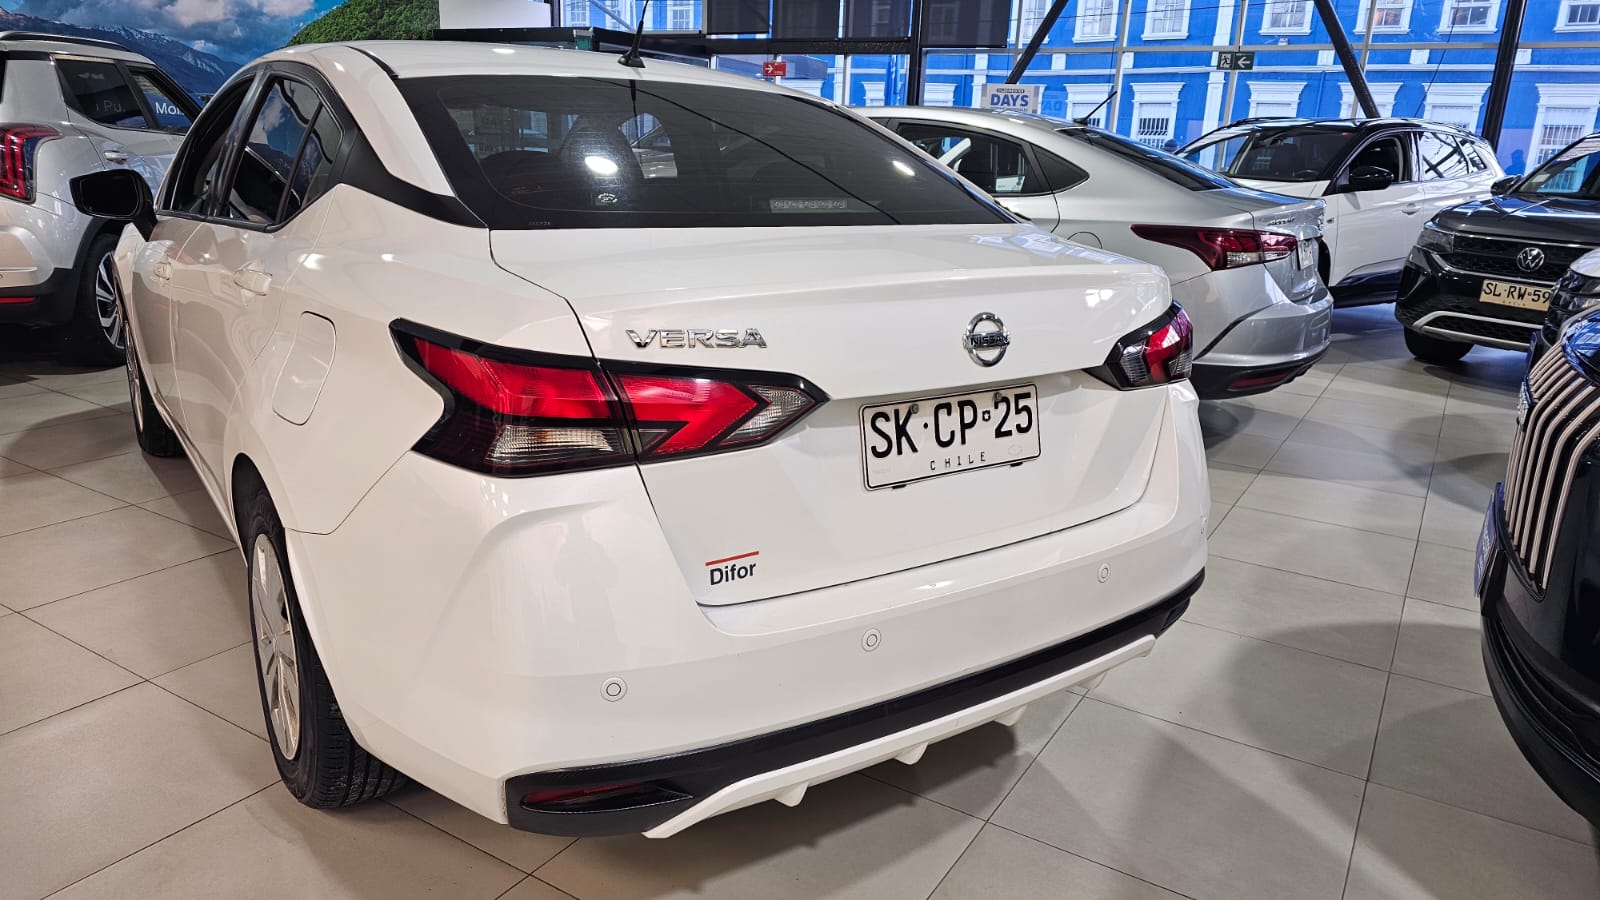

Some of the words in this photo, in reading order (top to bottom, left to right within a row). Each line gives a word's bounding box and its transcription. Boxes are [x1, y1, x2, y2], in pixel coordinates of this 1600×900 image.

[990, 93, 1029, 107] DAYS
[625, 328, 767, 348] VERSA
[970, 333, 1009, 346] NISSAN
[930, 452, 986, 471] CHILE
[709, 563, 757, 585] Difor
